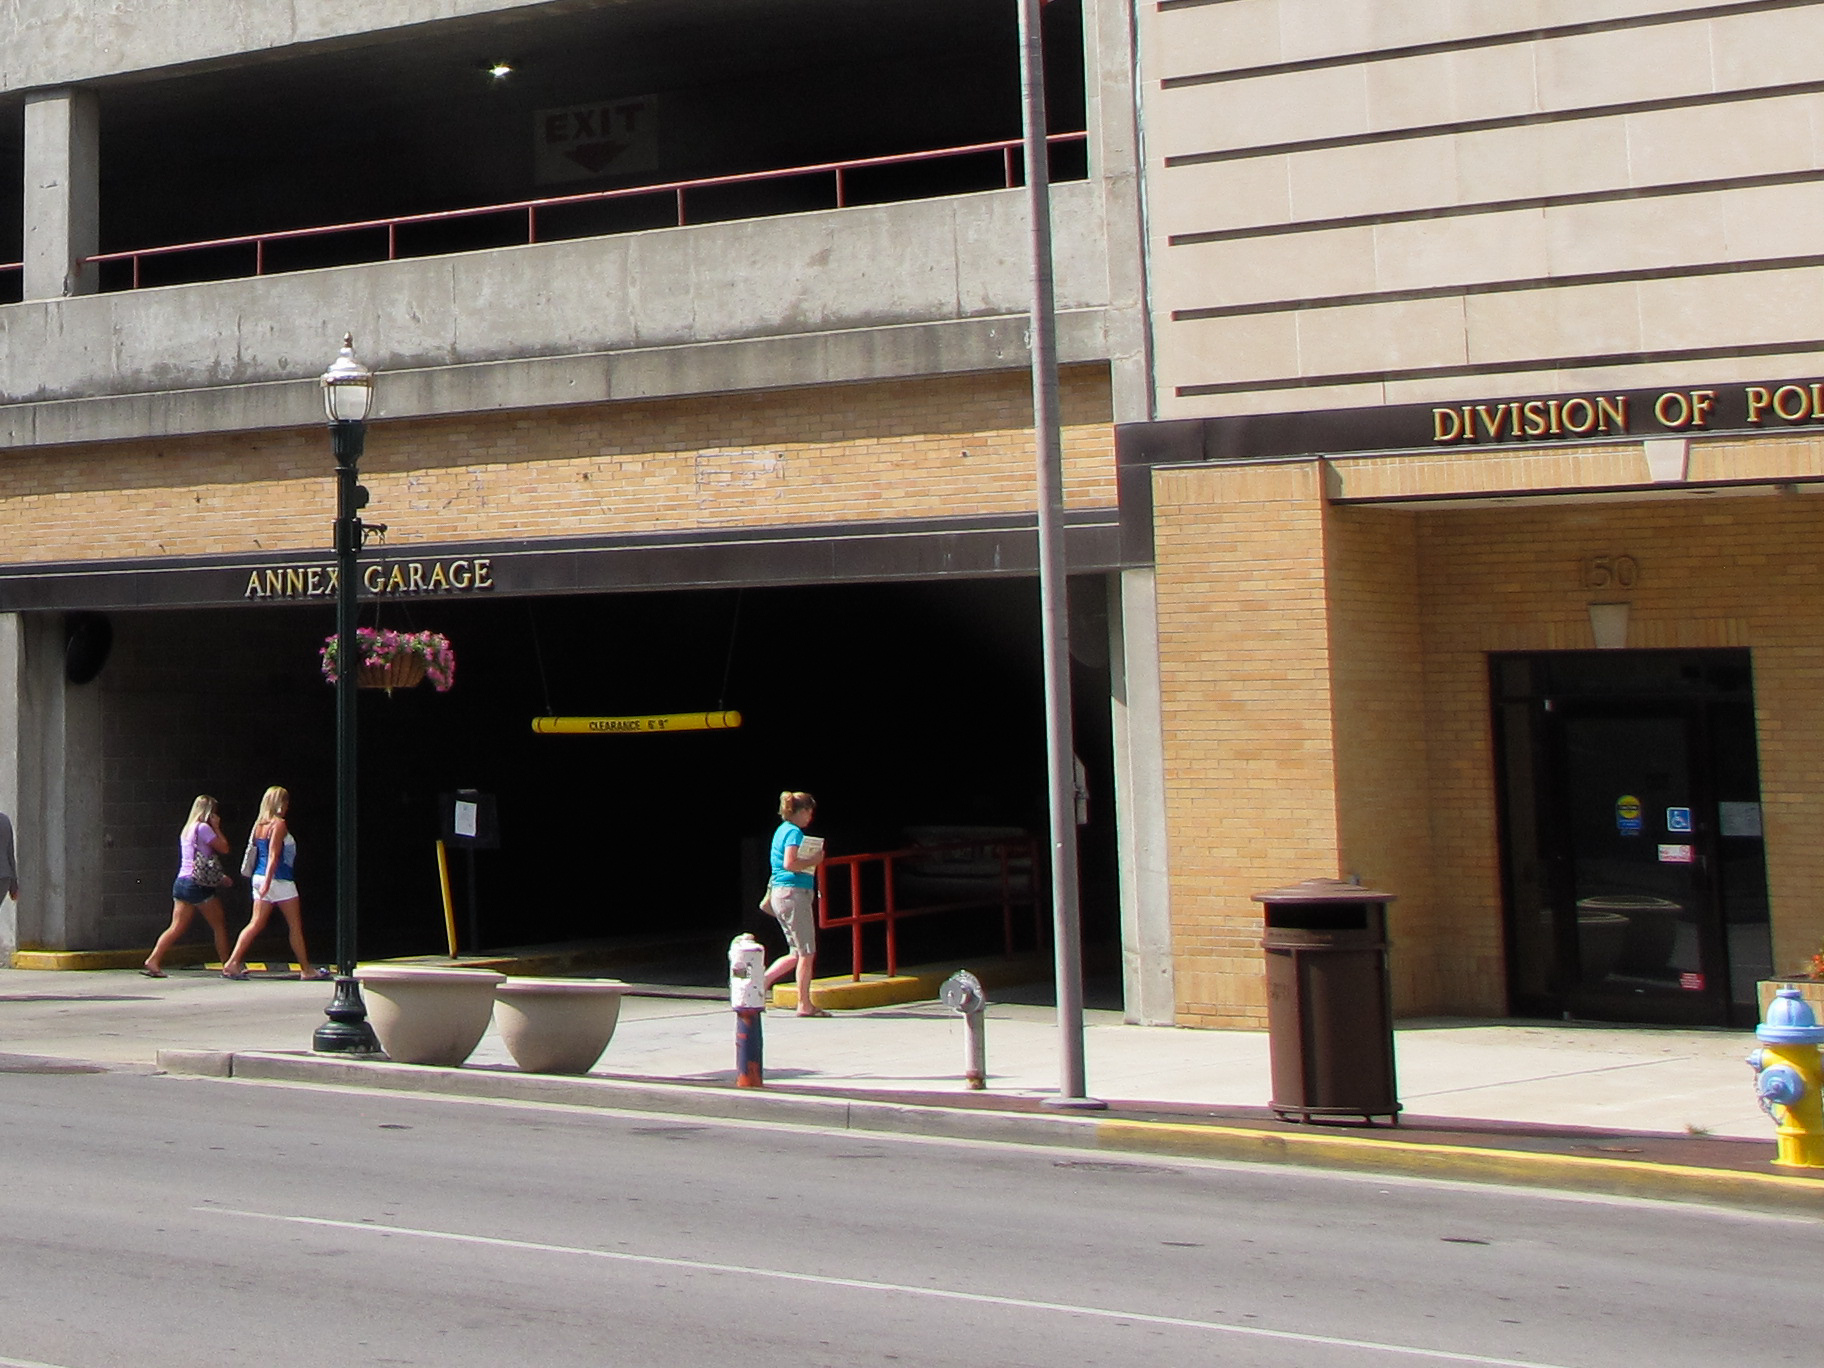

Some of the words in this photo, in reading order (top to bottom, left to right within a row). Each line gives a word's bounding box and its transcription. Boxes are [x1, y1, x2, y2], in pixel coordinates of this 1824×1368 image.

[545, 103, 646, 144] EXIT
[1432, 396, 1627, 441] DIVISION
[1655, 390, 1716, 428] OF
[244, 567, 340, 599] ANNEX
[363, 559, 493, 594] GARAGE
[589, 720, 642, 731] CLEARANCE
